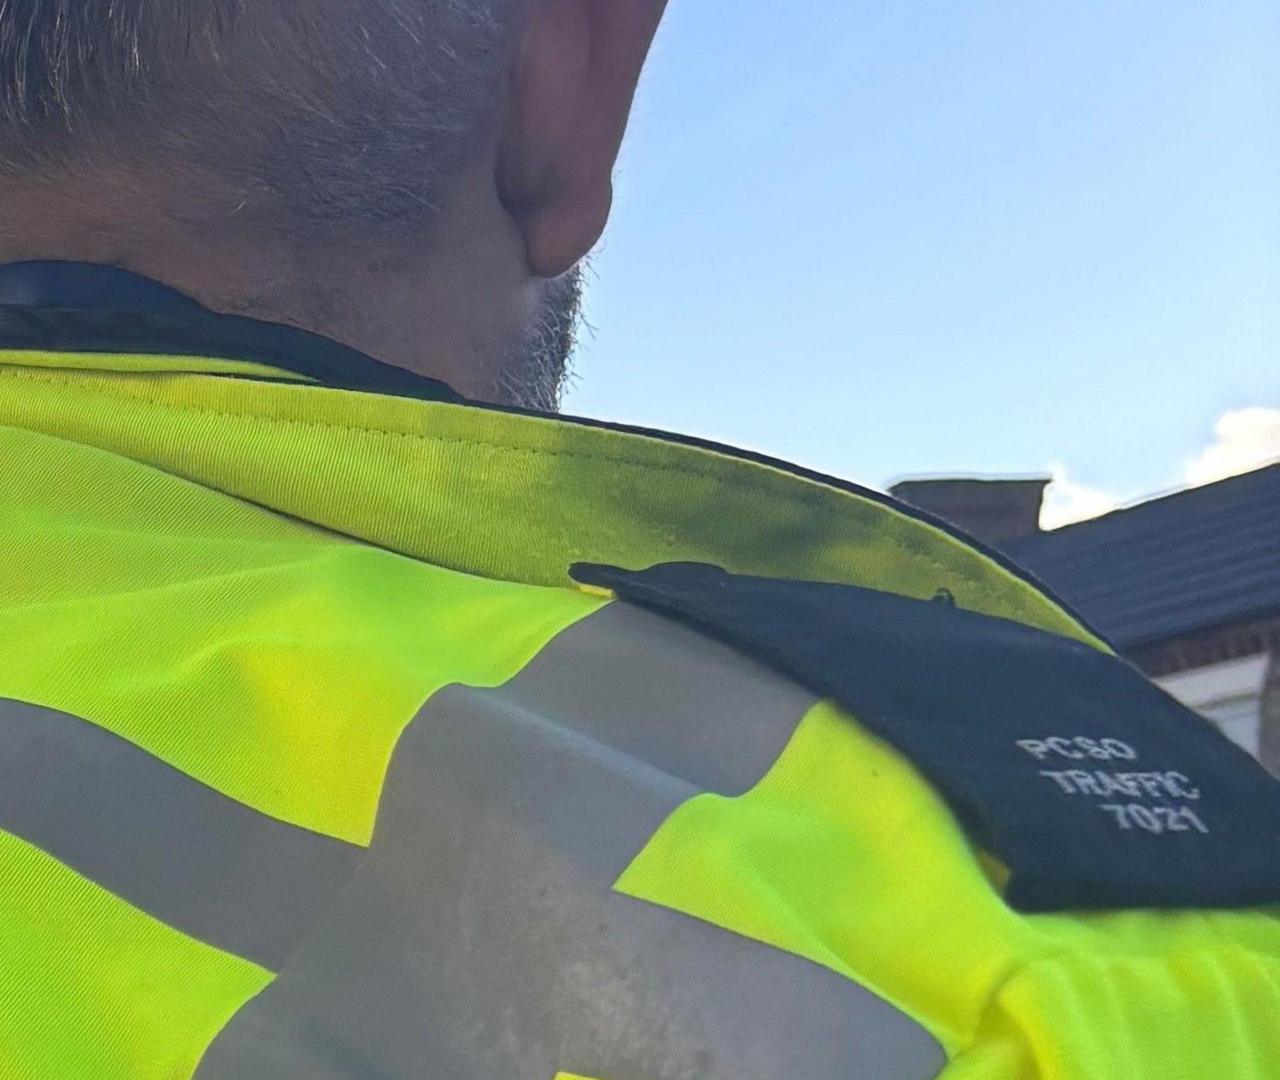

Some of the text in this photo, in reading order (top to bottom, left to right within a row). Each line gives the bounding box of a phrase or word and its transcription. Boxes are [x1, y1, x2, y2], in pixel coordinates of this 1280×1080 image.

[1015, 735, 1137, 761] PCSO
[1039, 768, 1200, 800] TRAFFIC
[1098, 803, 1209, 834] 7021
